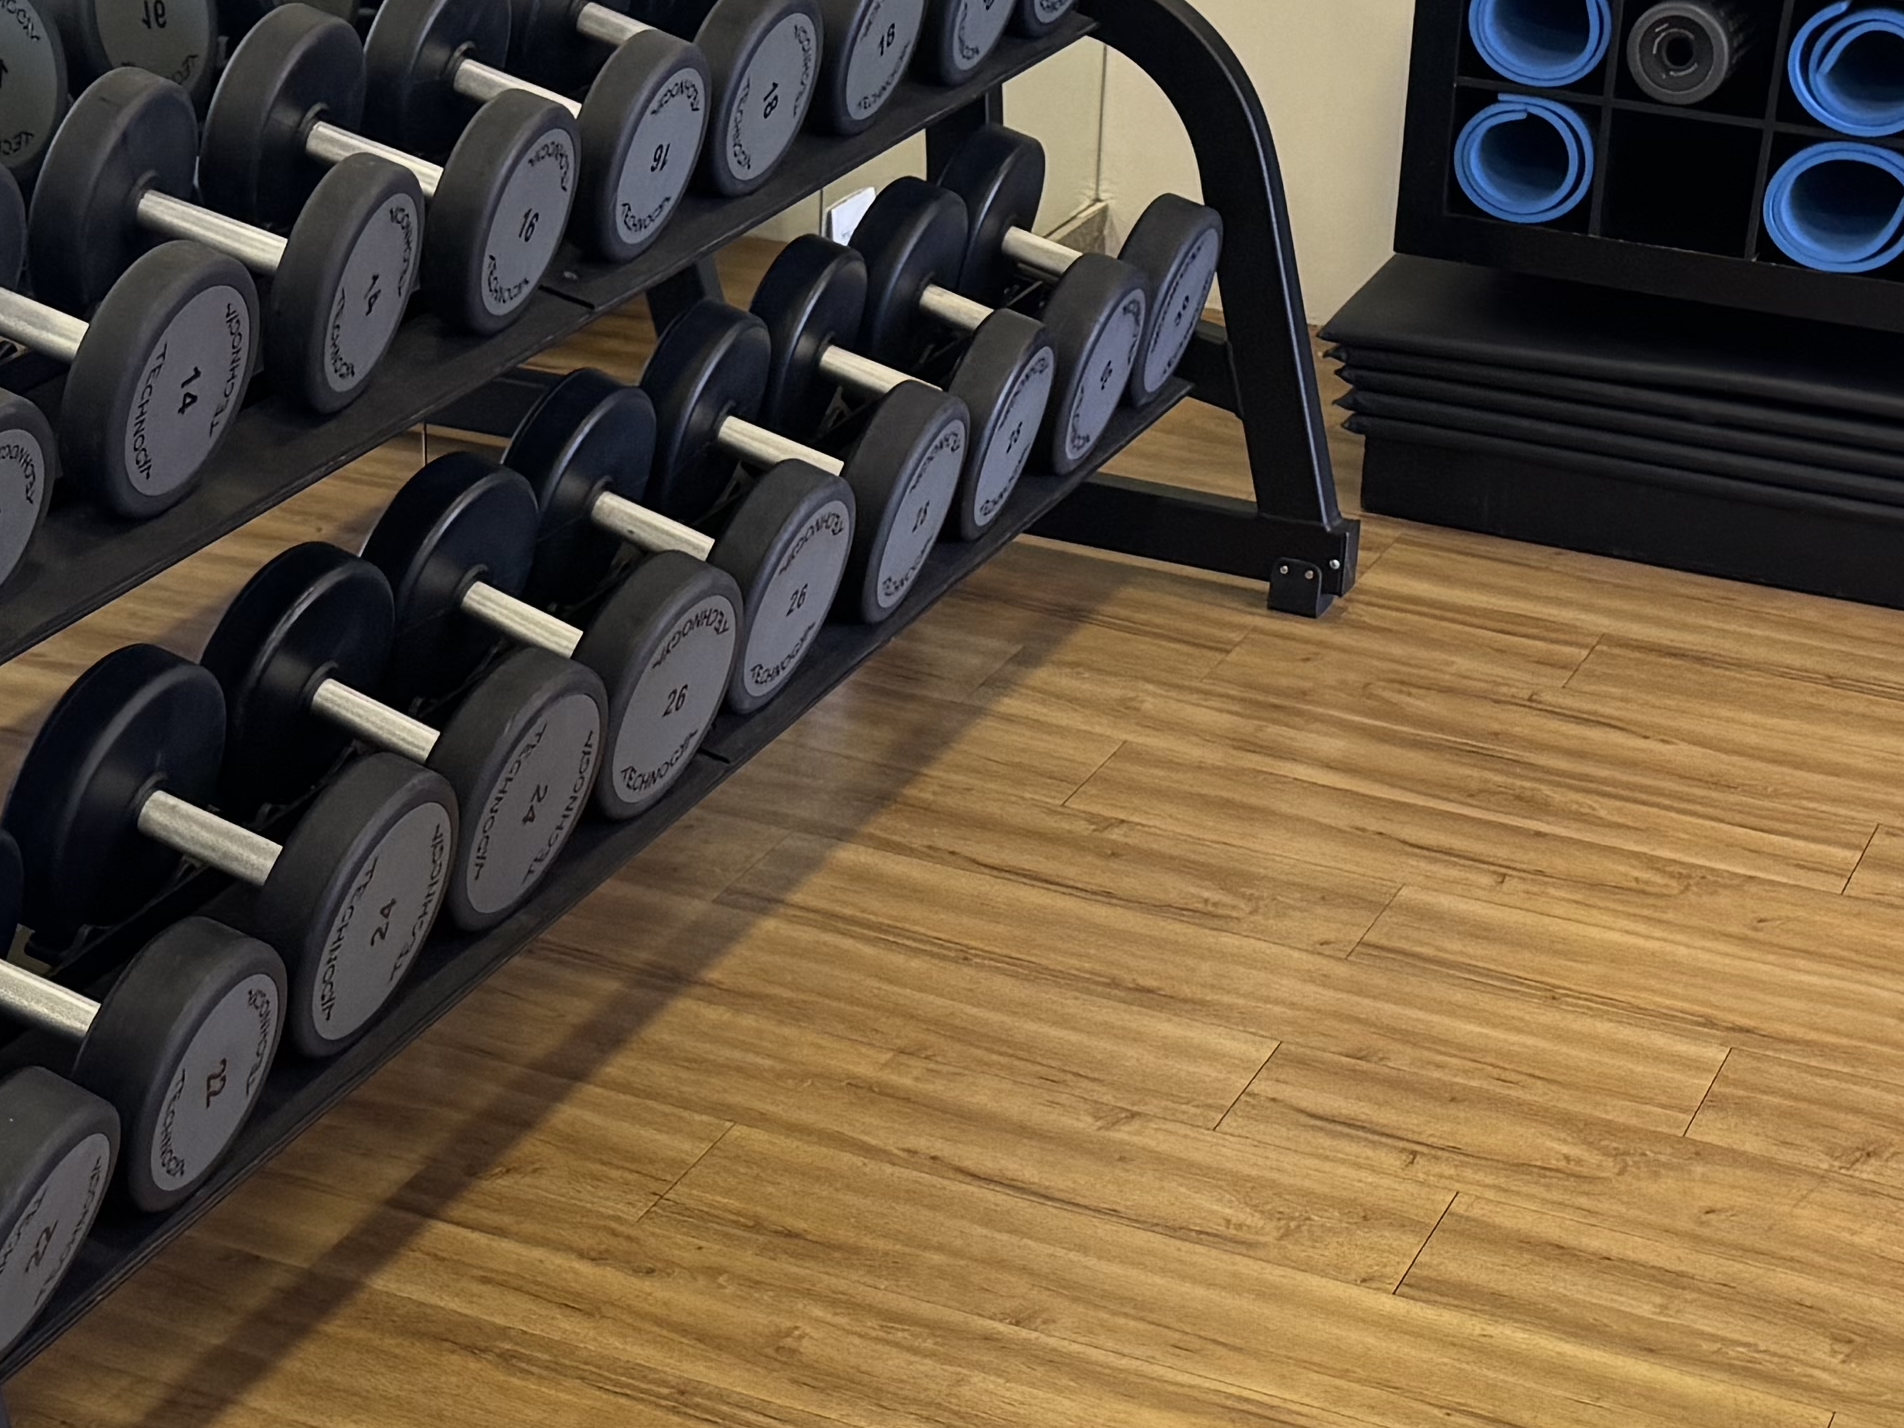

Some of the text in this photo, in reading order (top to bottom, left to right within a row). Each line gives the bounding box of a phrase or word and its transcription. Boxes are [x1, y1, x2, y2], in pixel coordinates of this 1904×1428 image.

[763, 82, 779, 119] 18
[519, 208, 539, 242] 16
[178, 366, 201, 415] 14
[661, 684, 688, 718] 26
